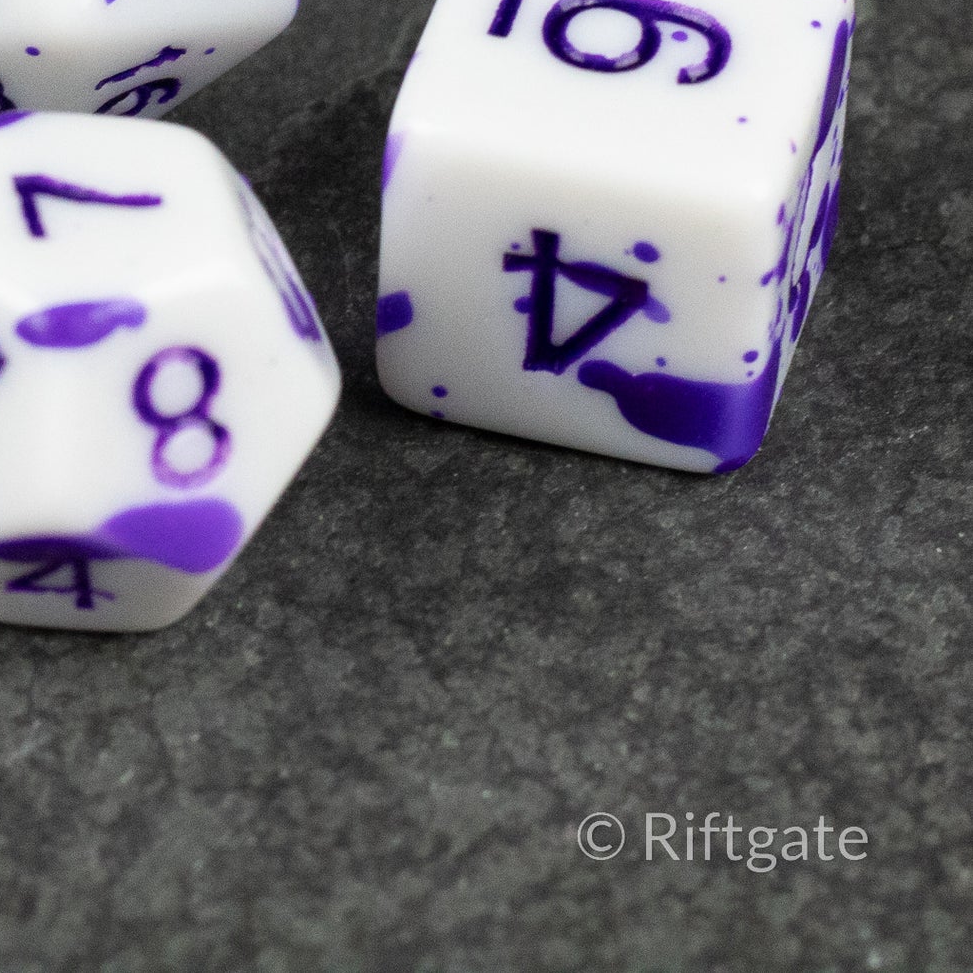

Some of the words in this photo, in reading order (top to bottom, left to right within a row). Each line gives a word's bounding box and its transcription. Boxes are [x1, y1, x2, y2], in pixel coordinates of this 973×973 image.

[12, 174, 163, 239] 7
[502, 228, 649, 375] 4
[132, 345, 233, 489] 8
[4, 542, 117, 610] 4
